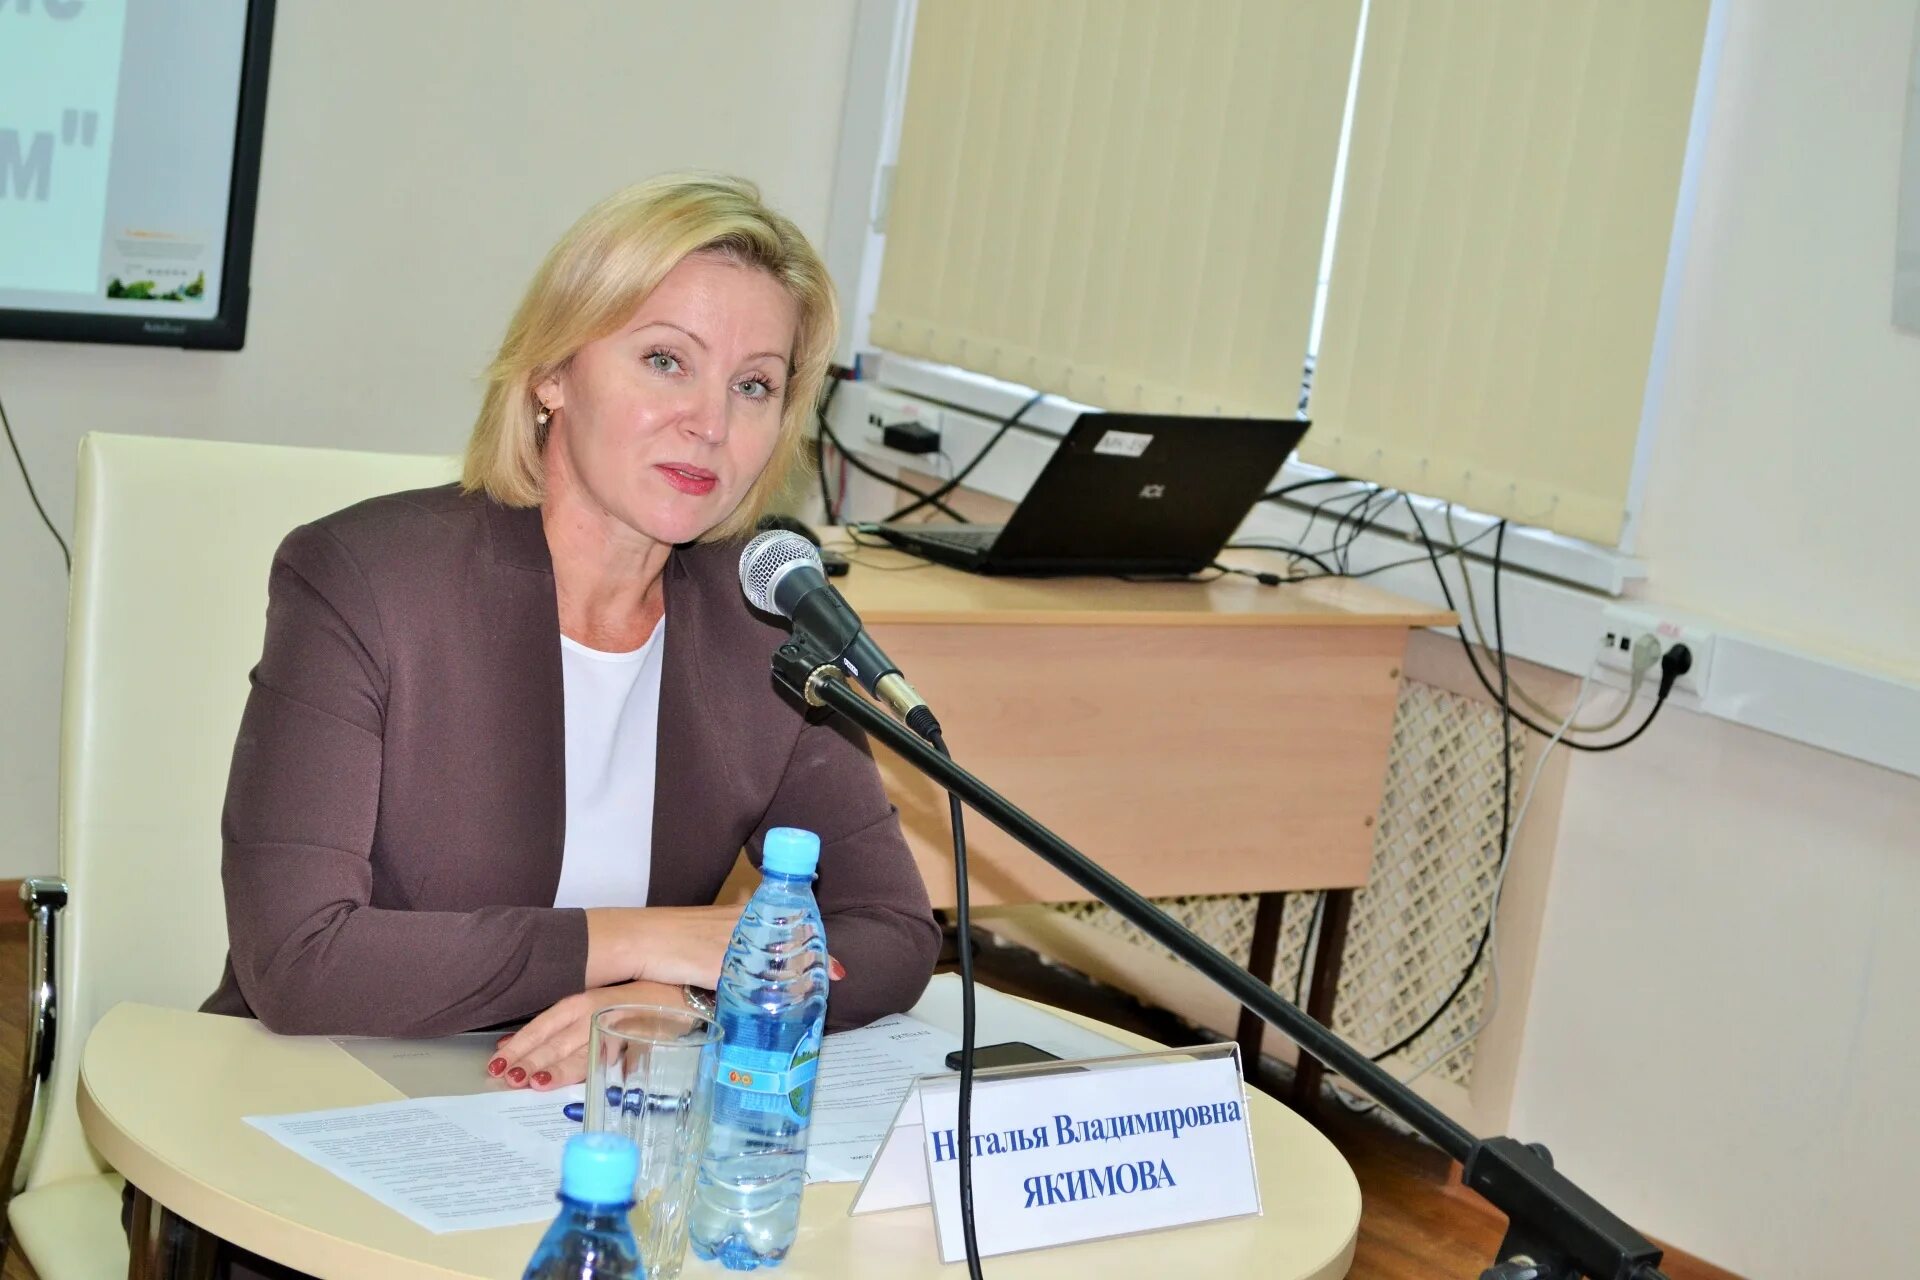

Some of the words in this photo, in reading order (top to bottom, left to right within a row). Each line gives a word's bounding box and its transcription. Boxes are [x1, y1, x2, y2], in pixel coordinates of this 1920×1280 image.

[930, 1126, 1050, 1163] Нталья
[1053, 1100, 1243, 1146] Владимировна
[1023, 1158, 1177, 1209] ЯКИМОВА
